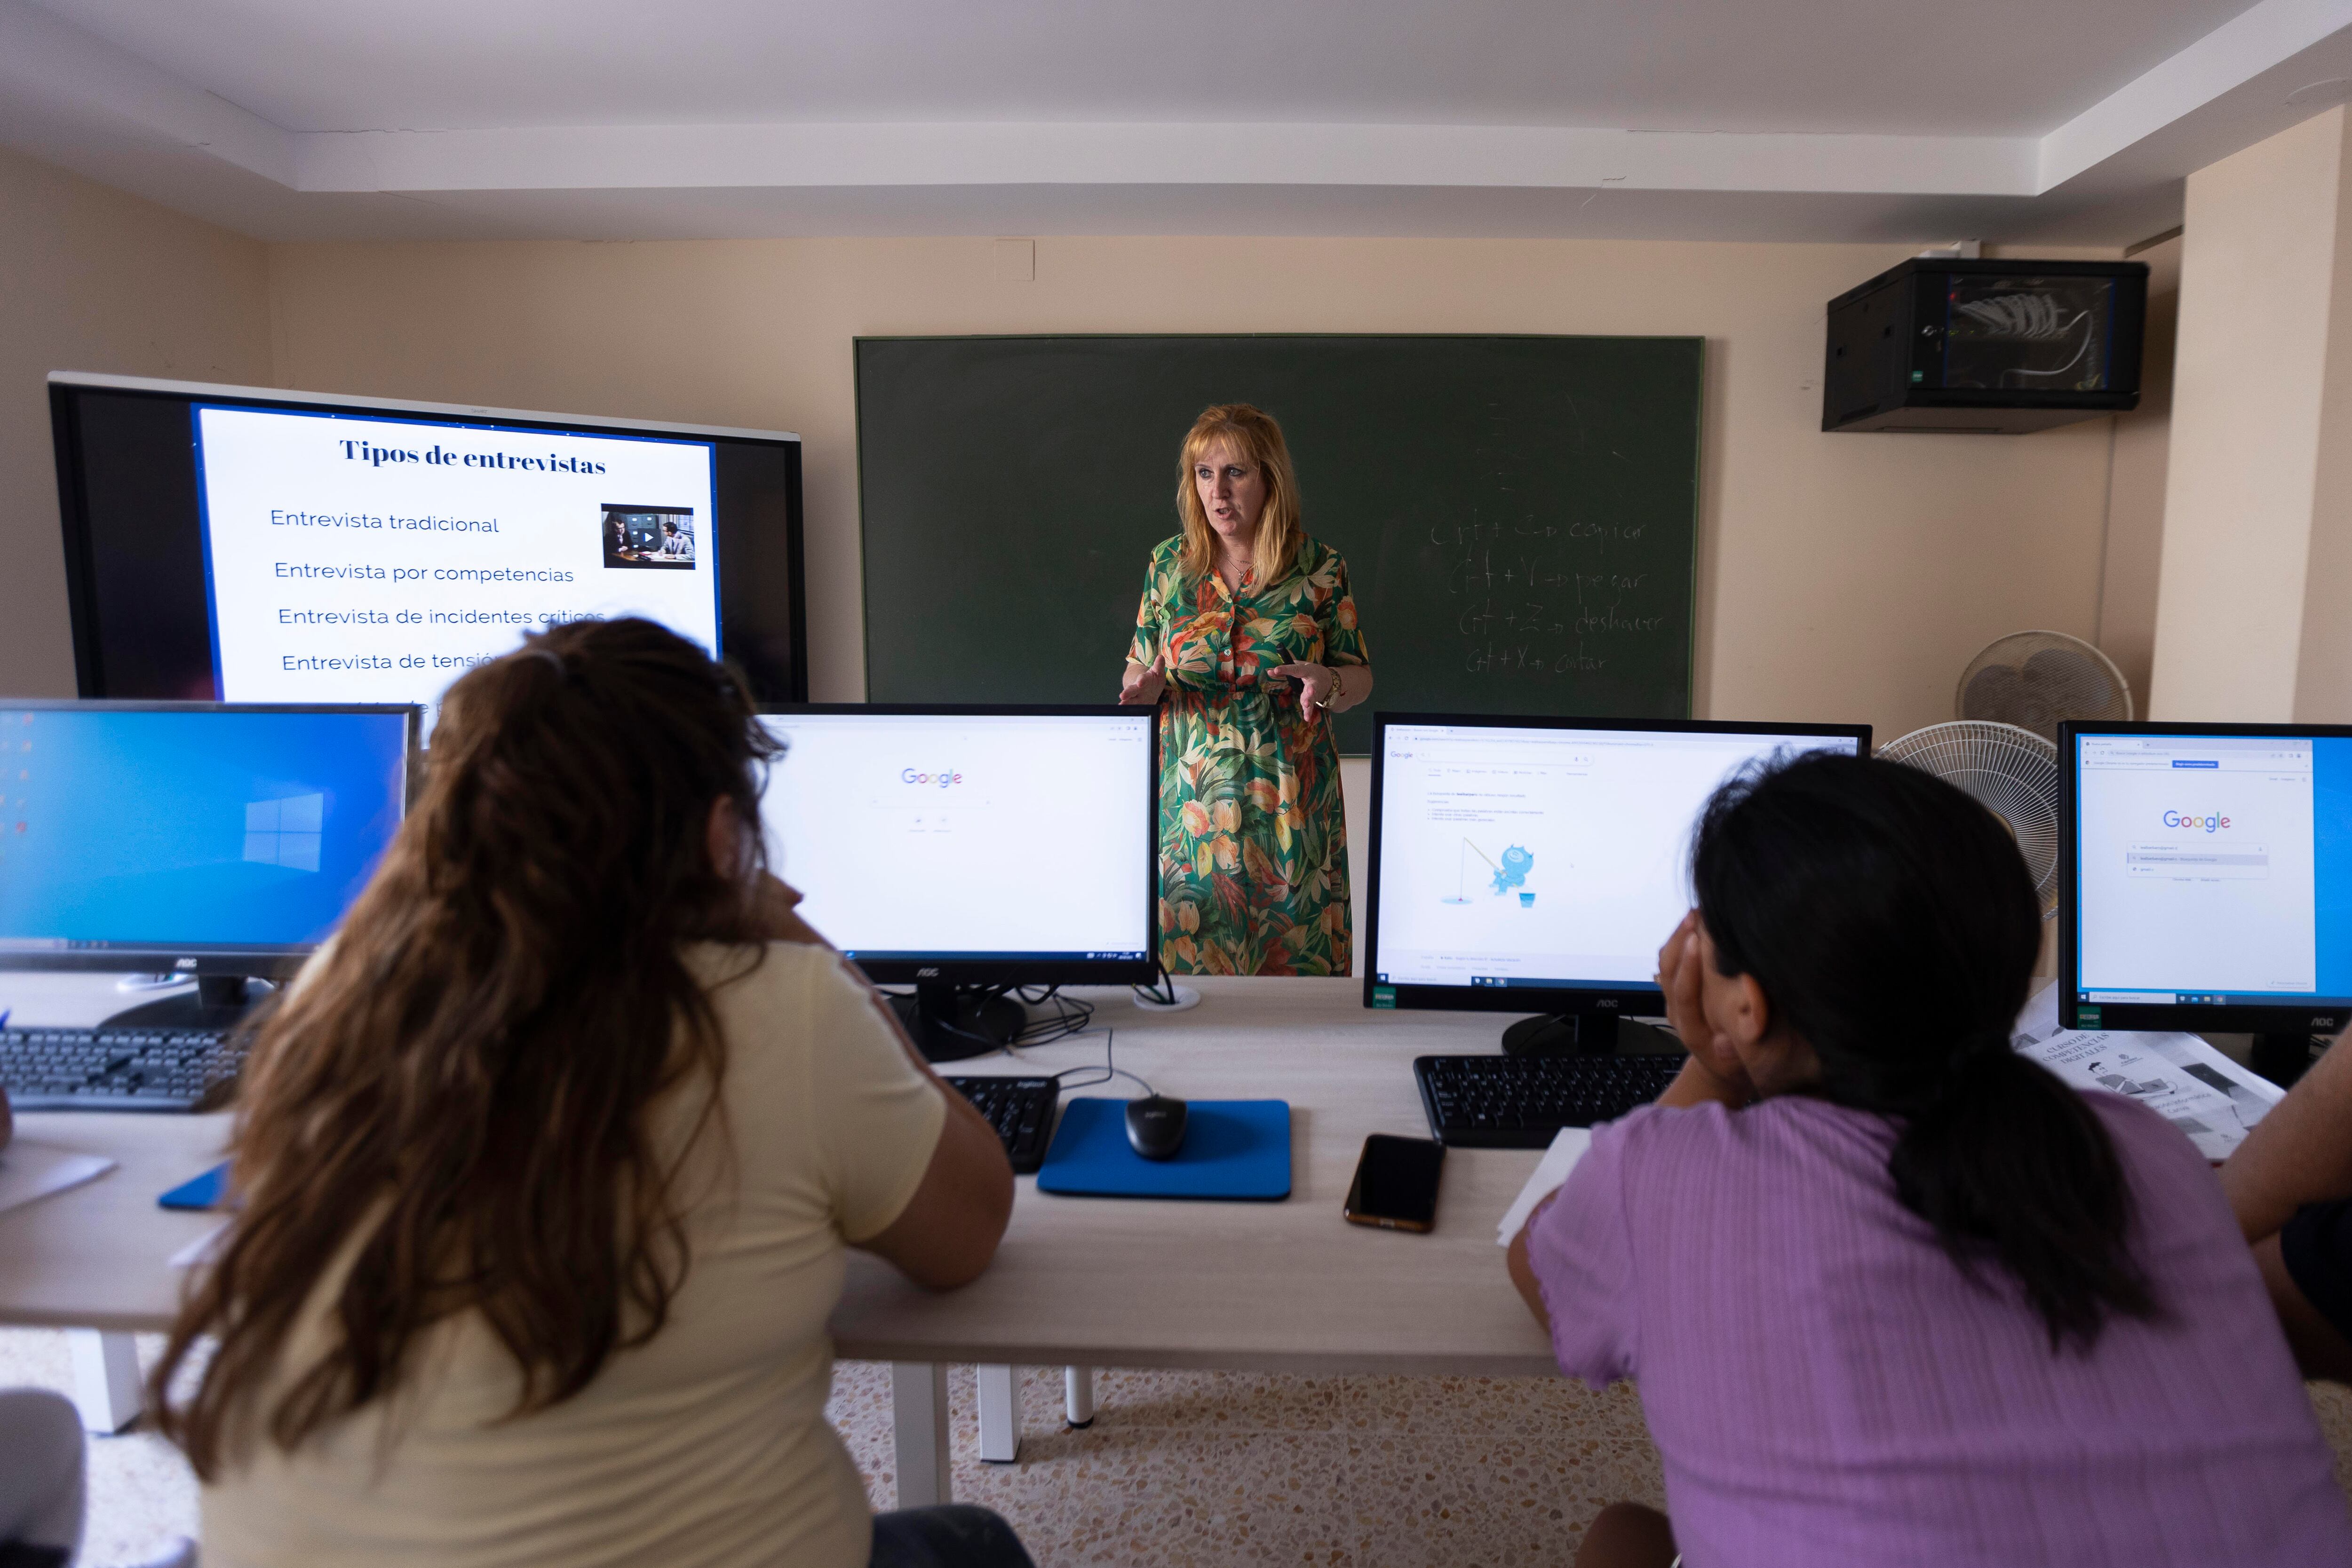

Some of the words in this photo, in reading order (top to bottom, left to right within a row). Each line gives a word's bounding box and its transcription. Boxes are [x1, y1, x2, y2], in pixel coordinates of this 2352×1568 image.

[340, 440, 419, 467] Tipos
[425, 445, 457, 466] de
[463, 452, 605, 475] entrevistas
[271, 510, 382, 529] Entrevista
[389, 515, 500, 532] tradicional
[275, 562, 386, 579] Entrevista
[393, 568, 428, 583] por
[434, 567, 573, 584] competencias
[279, 609, 389, 624] Entrevista
[396, 609, 422, 624] de
[429, 609, 532, 624] incidentes
[283, 654, 392, 670] Entrevista
[399, 654, 426, 668] de
[432, 653, 497, 668] tensió
[901, 768, 963, 789] Google
[2163, 810, 2231, 833] Google
[1596, 999, 1619, 1008] AOC
[2311, 1017, 2334, 1027] AOC
[2042, 1032, 2110, 1061] COMPETENCIAS
[2047, 1038, 2077, 1053] CURSO
[2075, 1032, 2090, 1042] DE
[2060, 1044, 2107, 1064] DIGITALES
